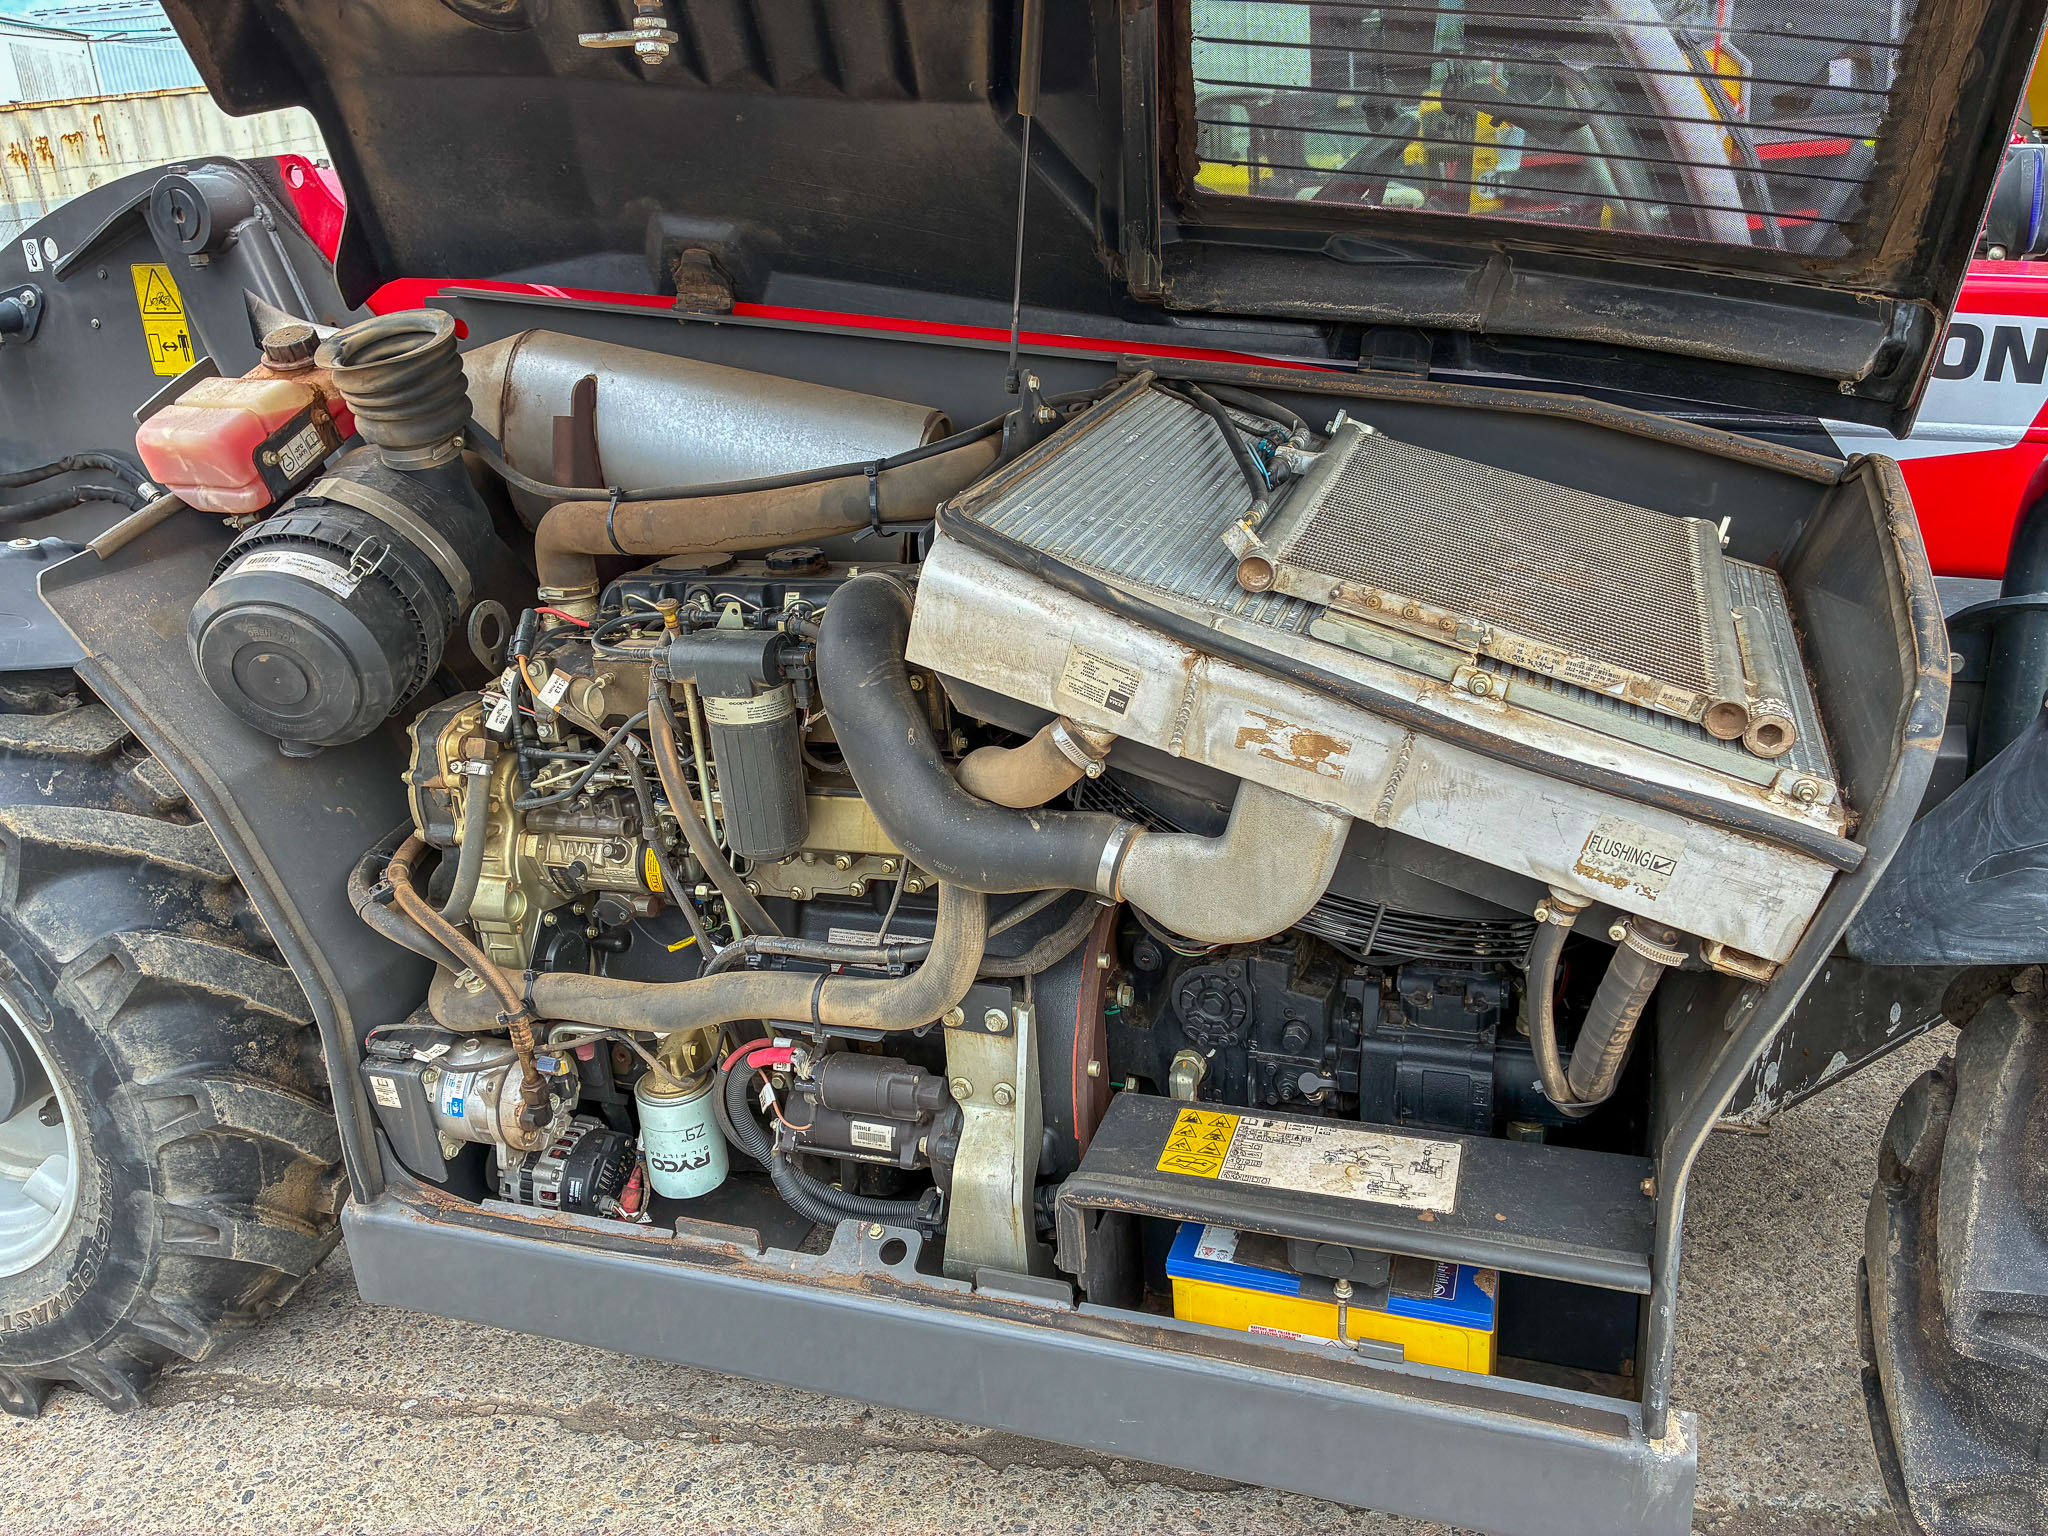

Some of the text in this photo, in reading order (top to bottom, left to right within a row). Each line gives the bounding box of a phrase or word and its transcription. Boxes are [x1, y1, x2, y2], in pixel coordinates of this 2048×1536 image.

[1931, 323, 2048, 384] ON
[1588, 834, 1651, 867] FLUSHING
[650, 1144, 709, 1159] OIL FILTER
[651, 1151, 711, 1173] RYCO
